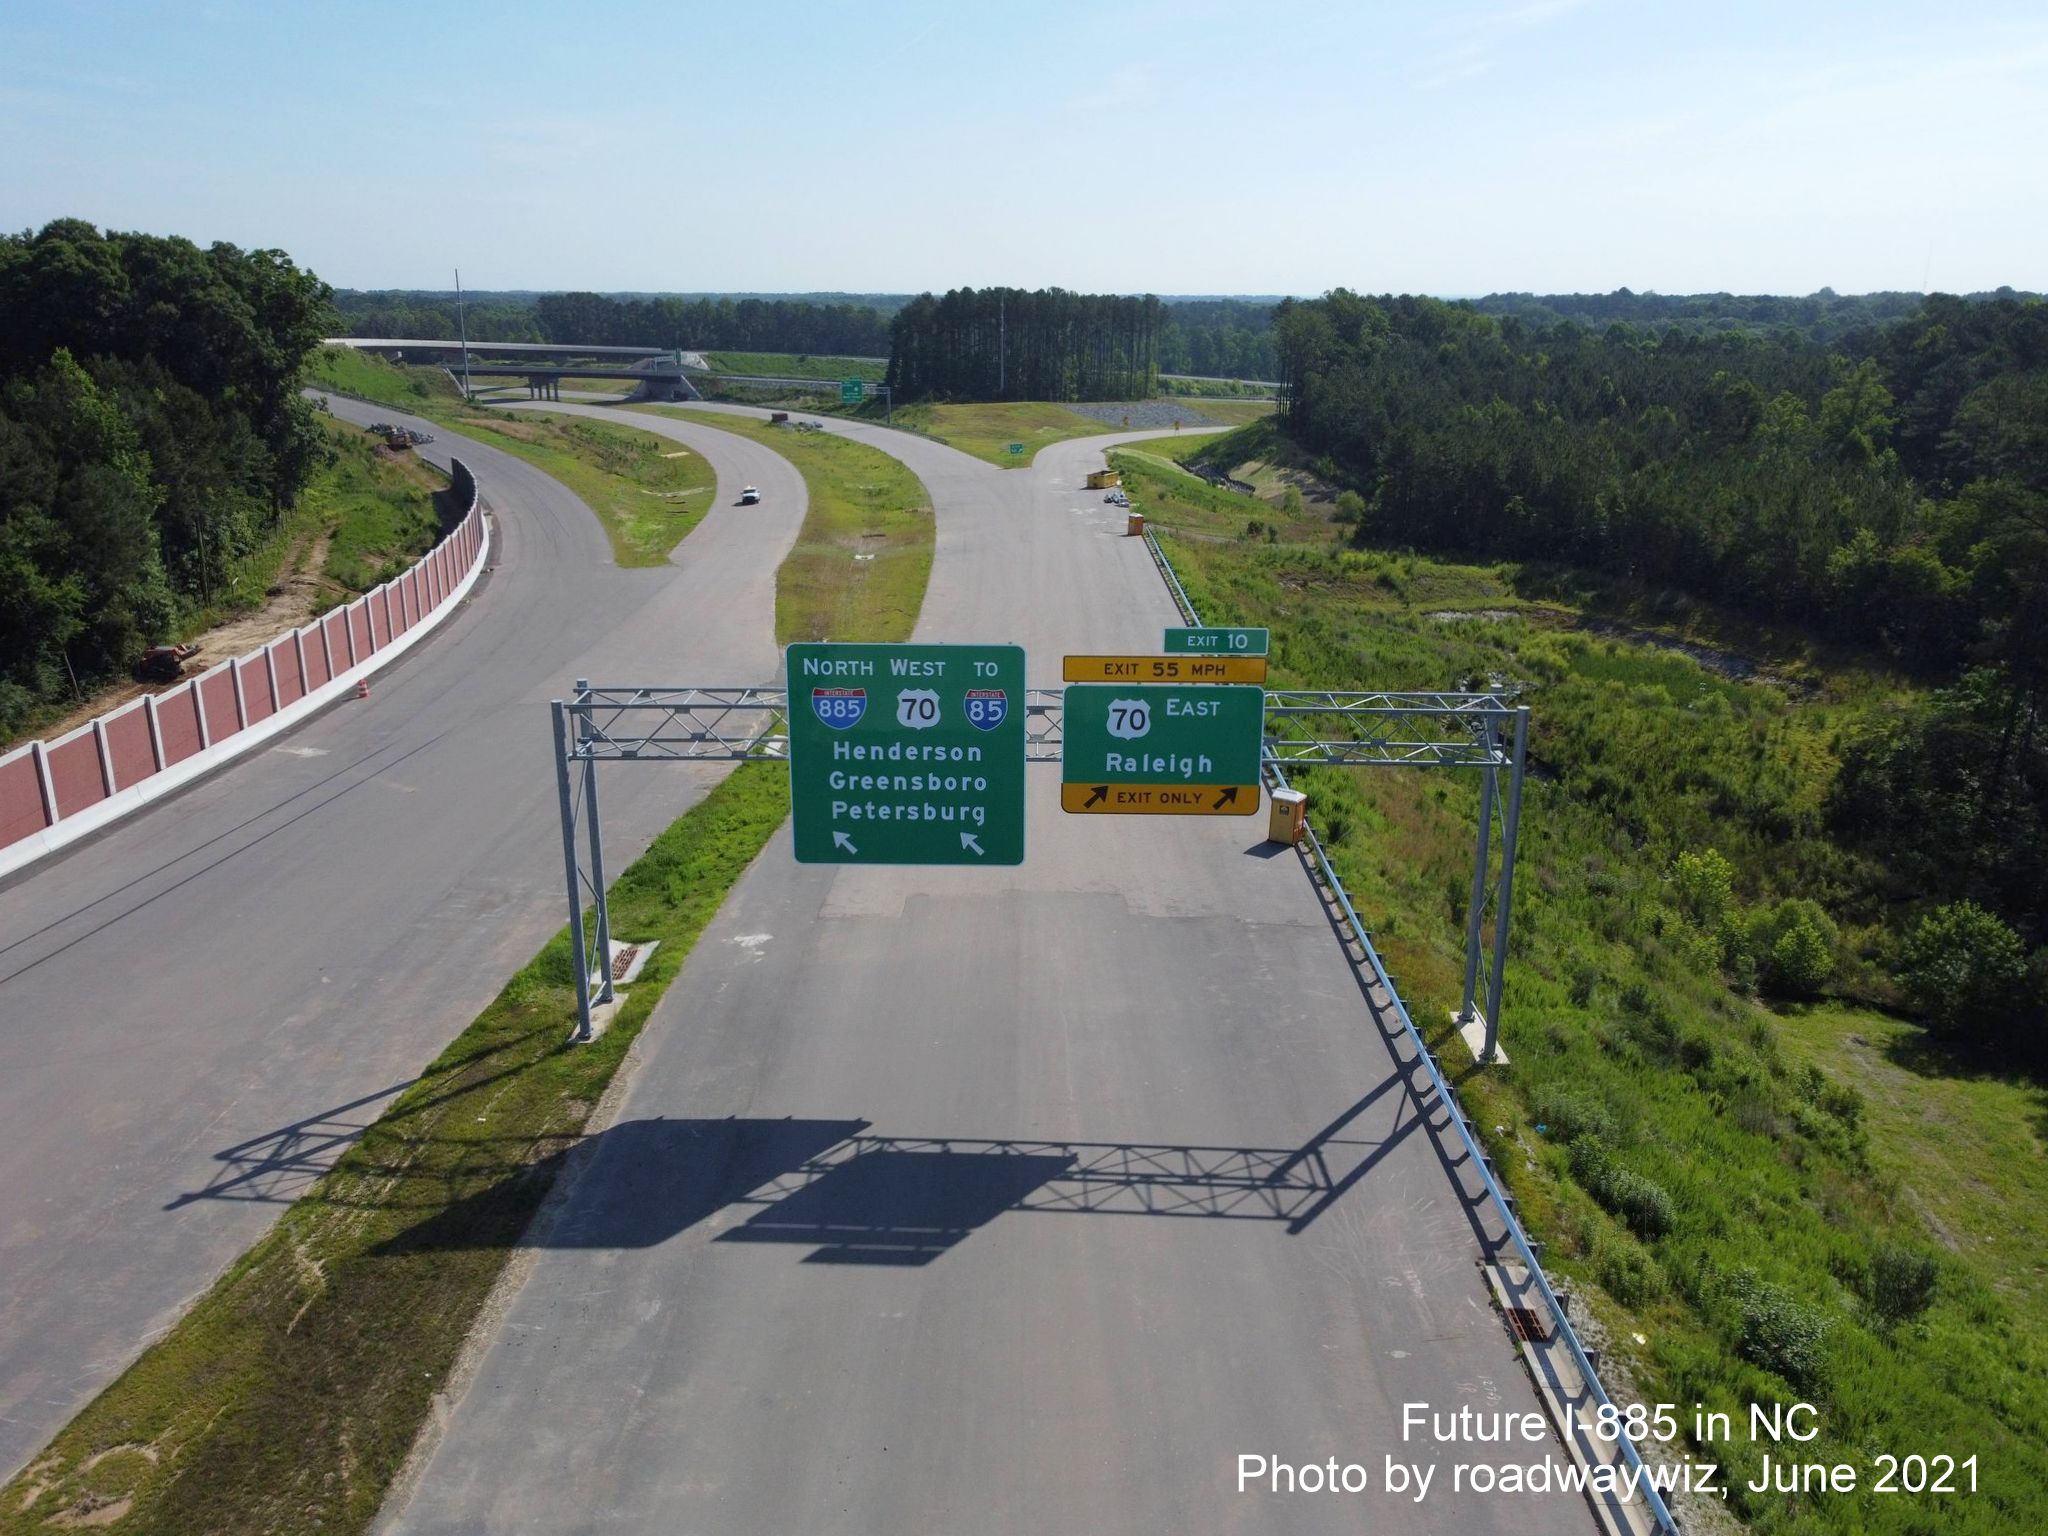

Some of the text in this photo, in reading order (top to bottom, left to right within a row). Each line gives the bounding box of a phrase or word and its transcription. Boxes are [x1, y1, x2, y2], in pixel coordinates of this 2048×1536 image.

[1187, 634, 1248, 649] EXIT 10
[803, 658, 999, 677] NORTH WEST TO
[1104, 662, 1226, 677] EXIT 55 MPH
[818, 699, 861, 718] 885
[901, 698, 936, 720] 70
[969, 700, 1003, 722] 85
[1166, 699, 1221, 716] EAST
[1111, 708, 1146, 731] 70
[833, 741, 982, 761] Henderson
[1105, 753, 1212, 779] Raleigh
[829, 771, 987, 791] Greensboro
[1117, 792, 1203, 805] EXIT ONLY
[832, 800, 985, 827] Petersburg
